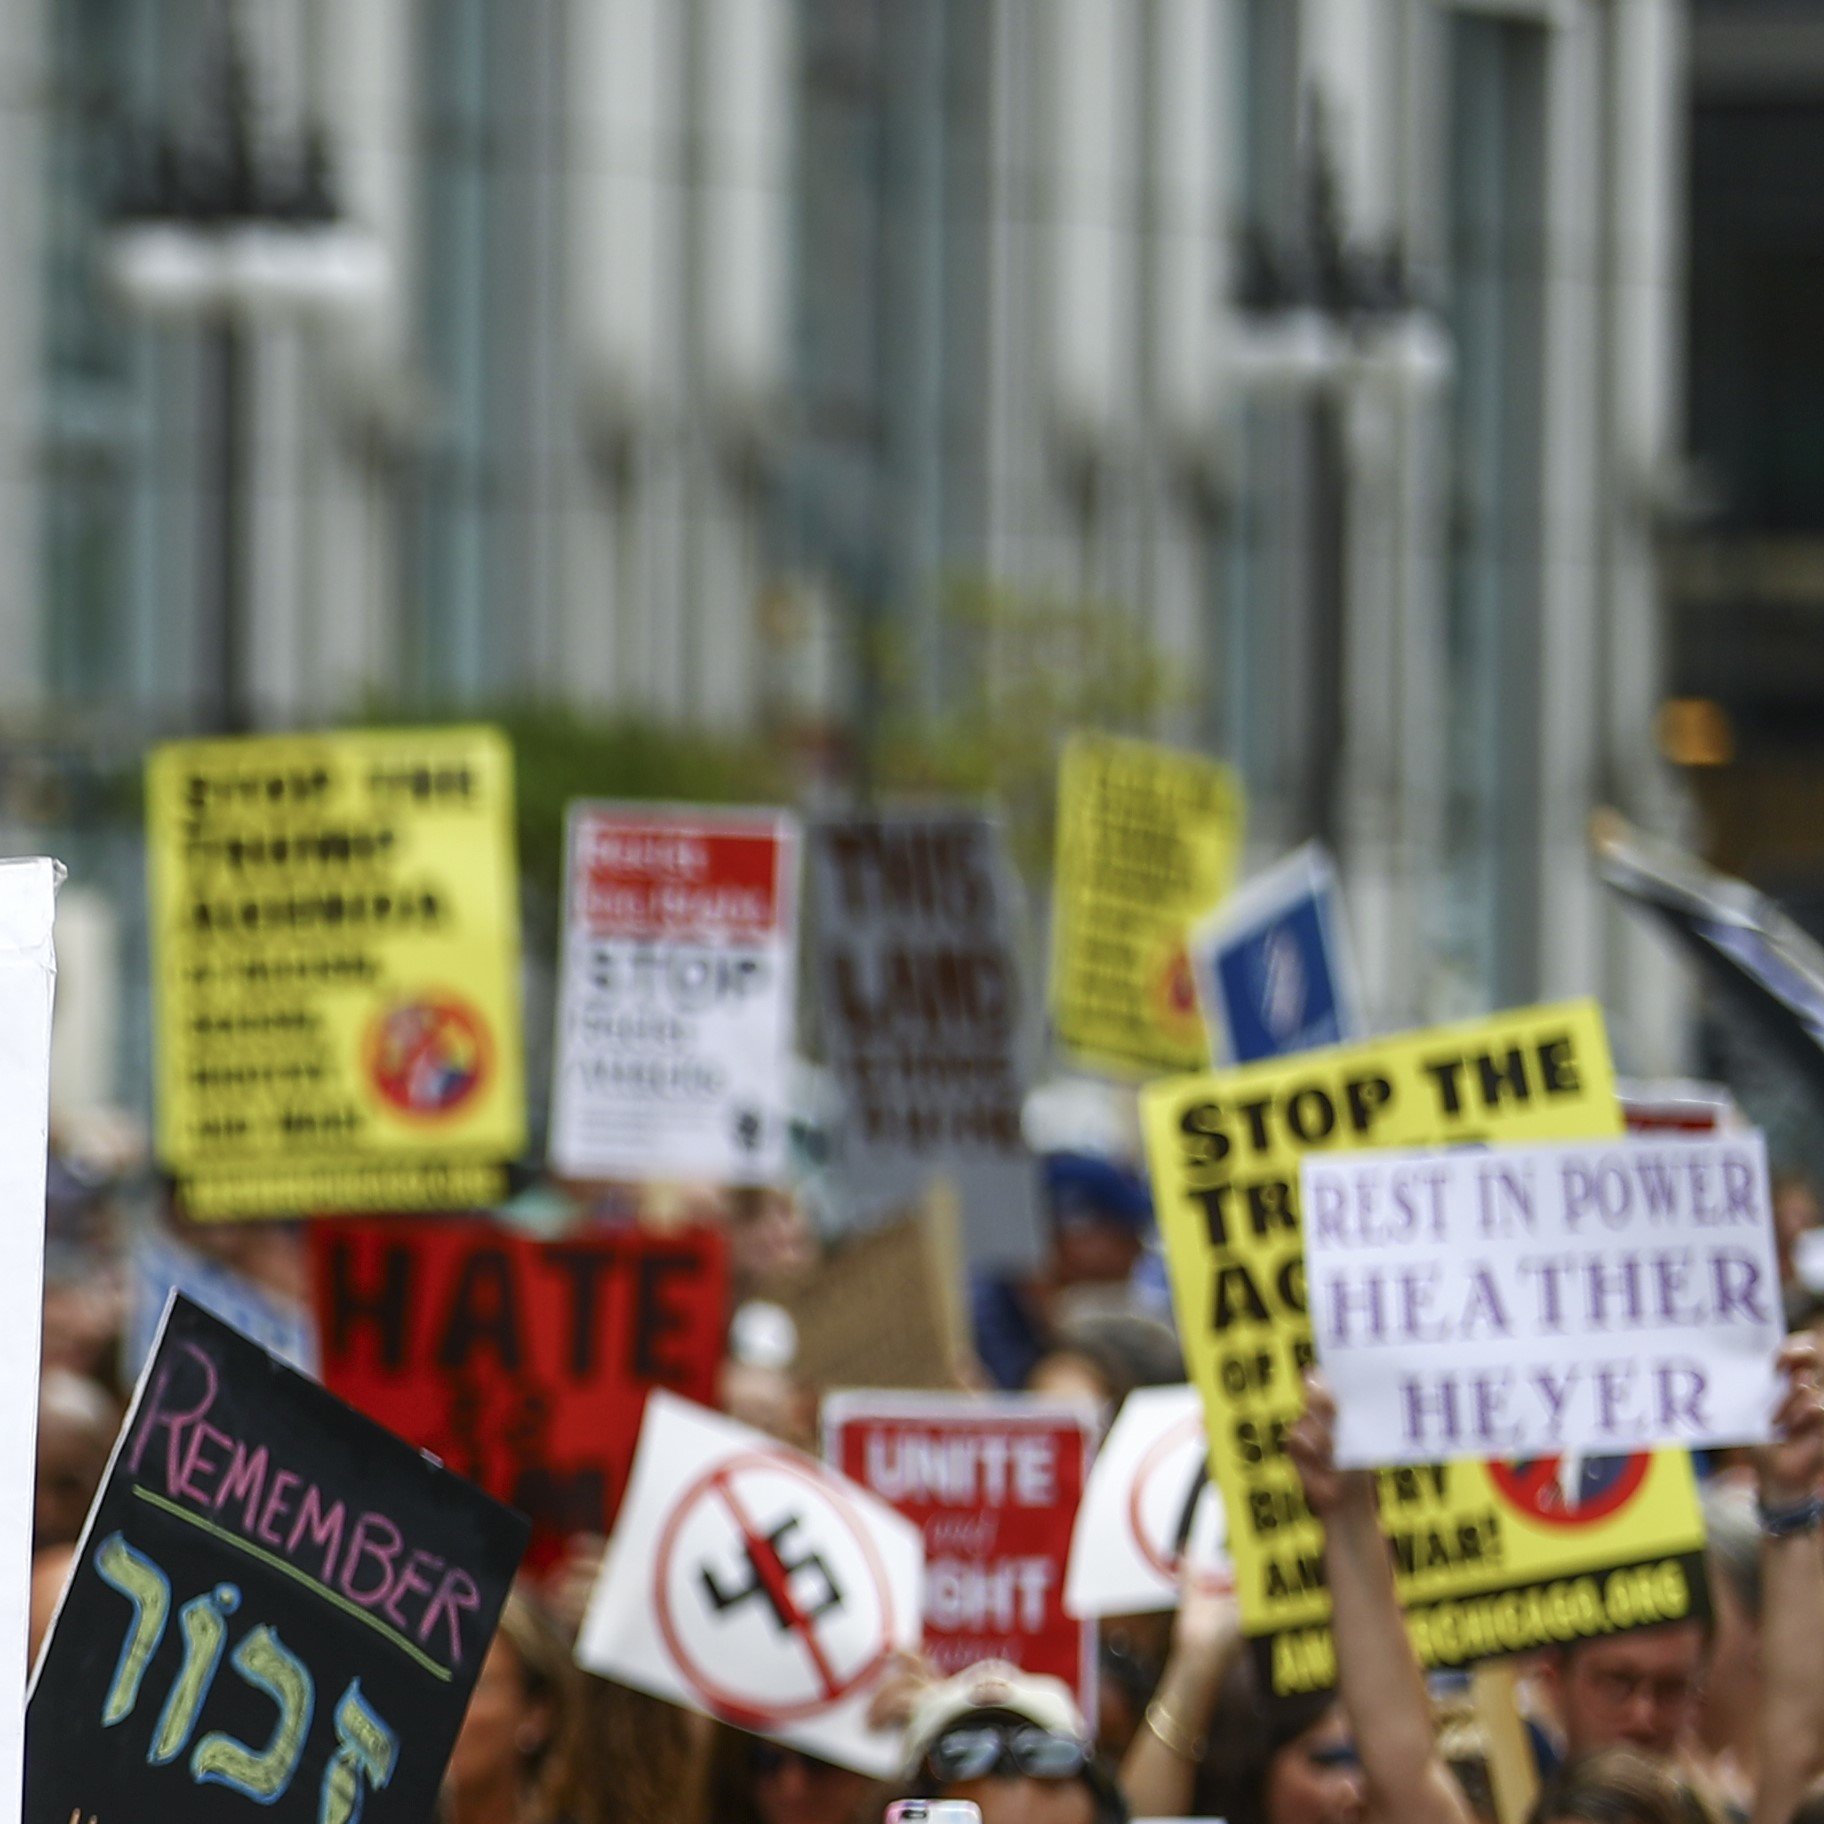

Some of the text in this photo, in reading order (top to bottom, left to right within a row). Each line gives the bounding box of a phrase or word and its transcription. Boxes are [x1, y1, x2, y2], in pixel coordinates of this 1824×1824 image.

[1176, 1034, 1585, 1169] STOP THE
[1308, 1142, 1764, 1252] REST IN POWER
[327, 1240, 704, 1385] HATE
[1324, 1248, 1773, 1348] HEATHER
[1398, 1360, 1718, 1452] HEYER
[130, 1340, 483, 1664] REMEMBER
[864, 1424, 1058, 1507] UNITE
